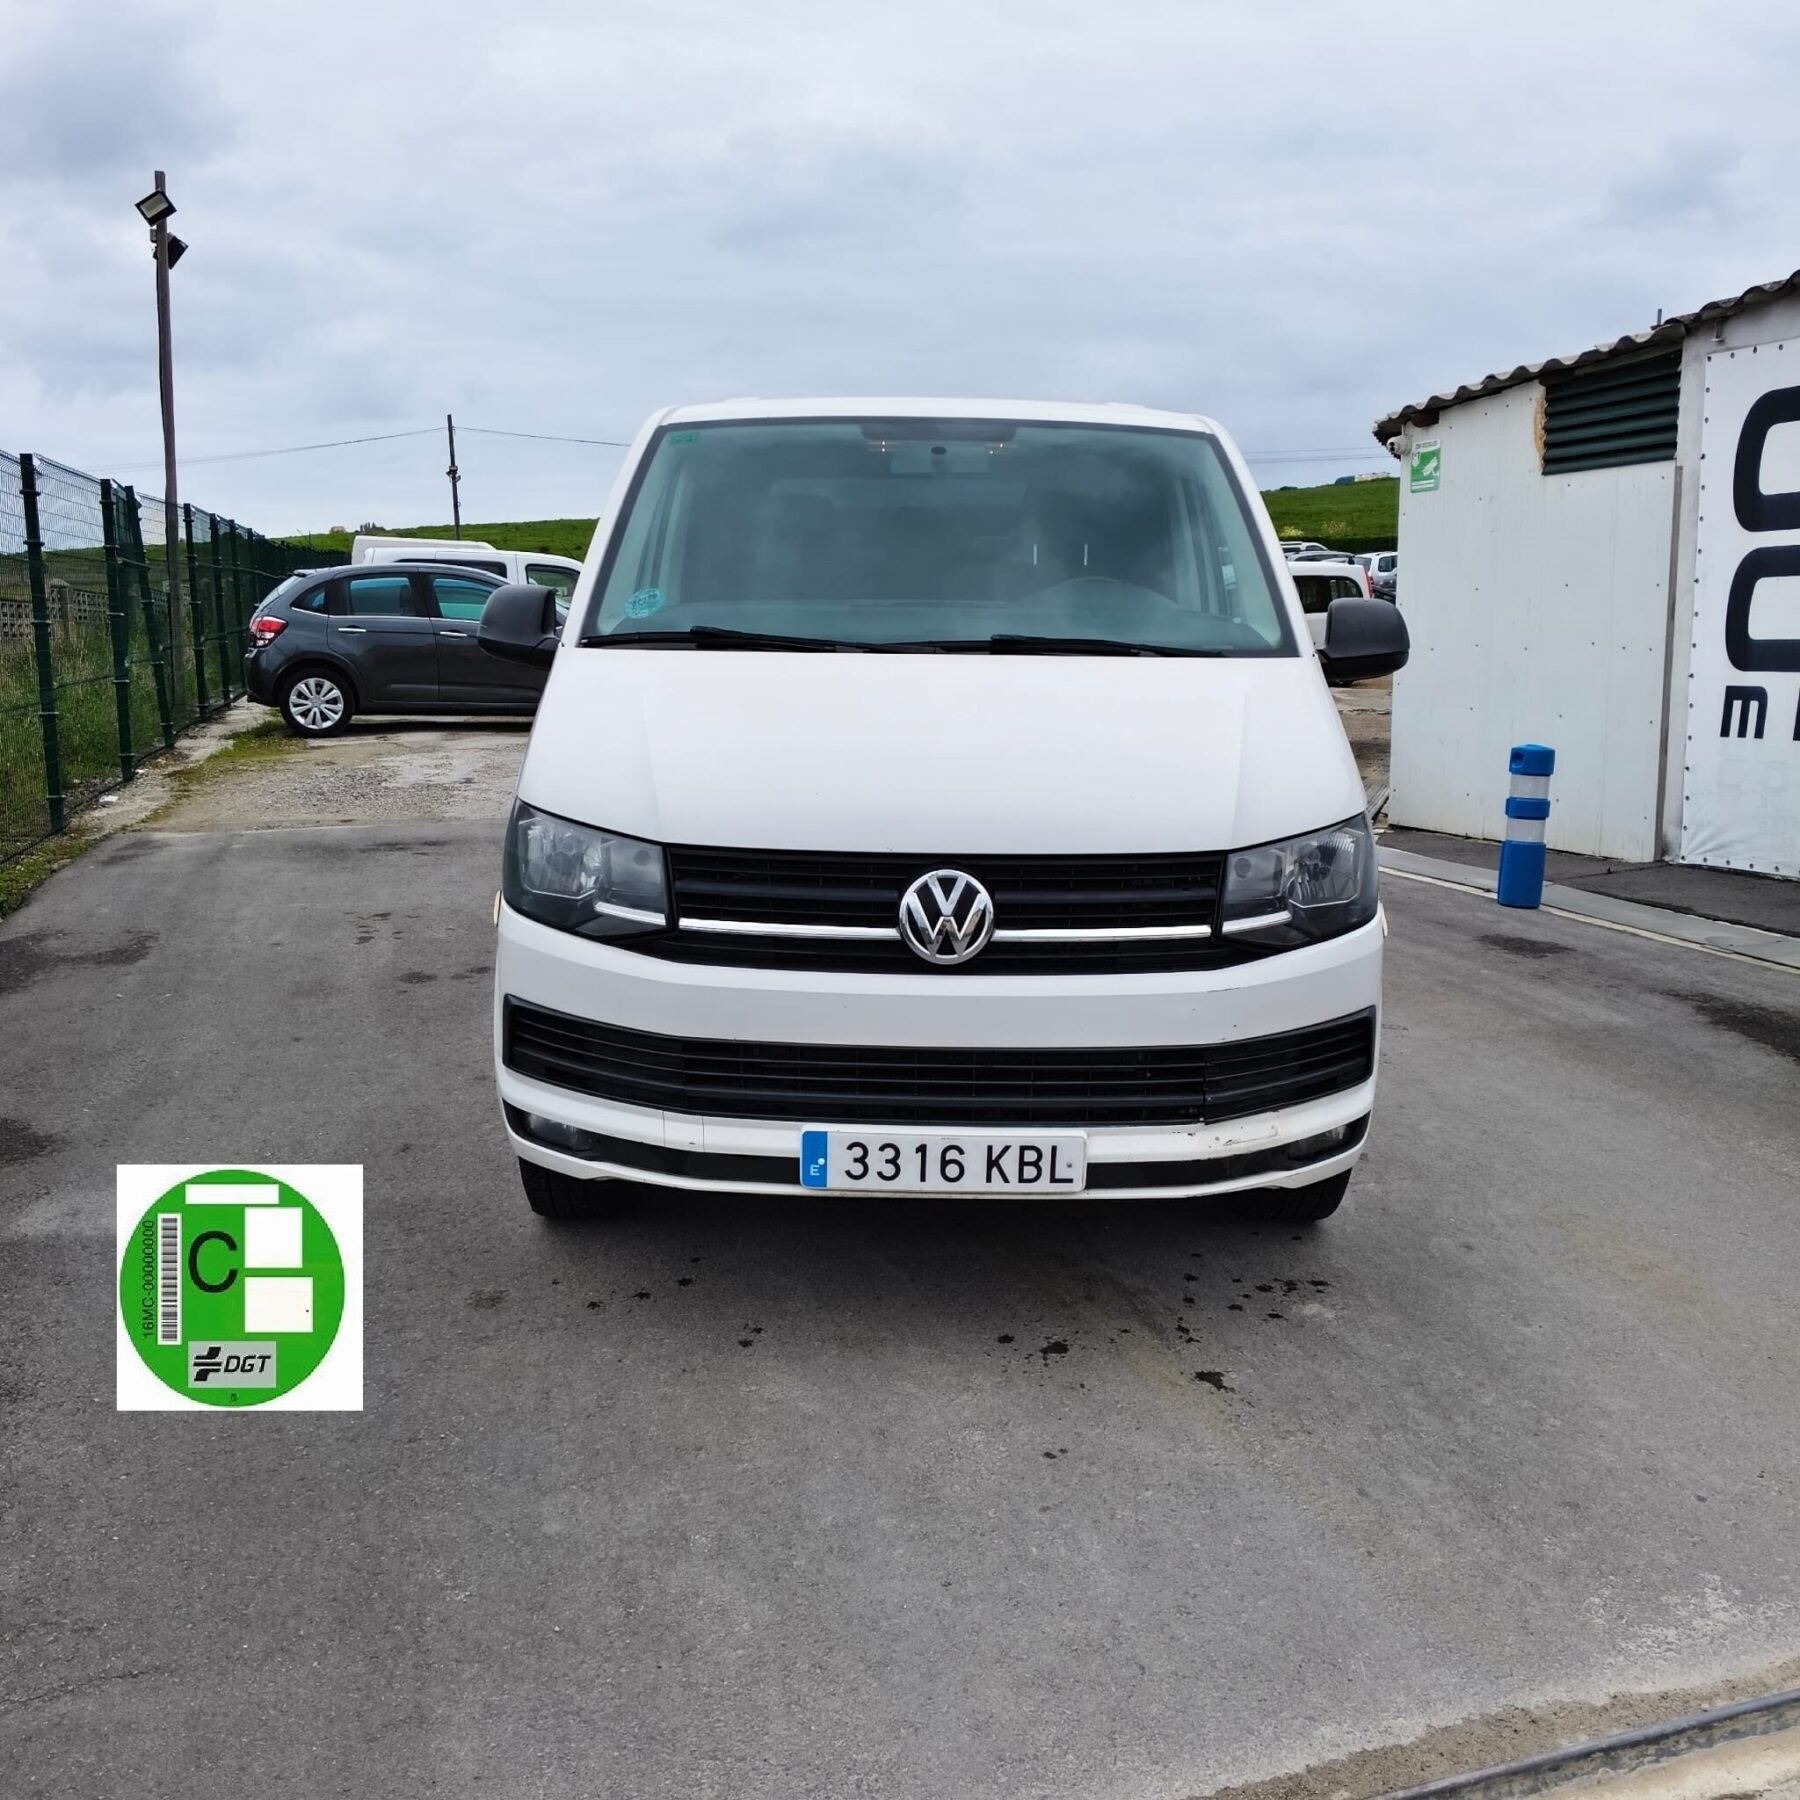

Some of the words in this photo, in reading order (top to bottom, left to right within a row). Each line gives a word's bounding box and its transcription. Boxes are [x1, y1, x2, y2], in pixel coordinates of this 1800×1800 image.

[900, 870, 992, 963] VW
[809, 1164, 820, 1176] E
[844, 1141, 965, 1183] 3316
[985, 1144, 1074, 1184] KBL
